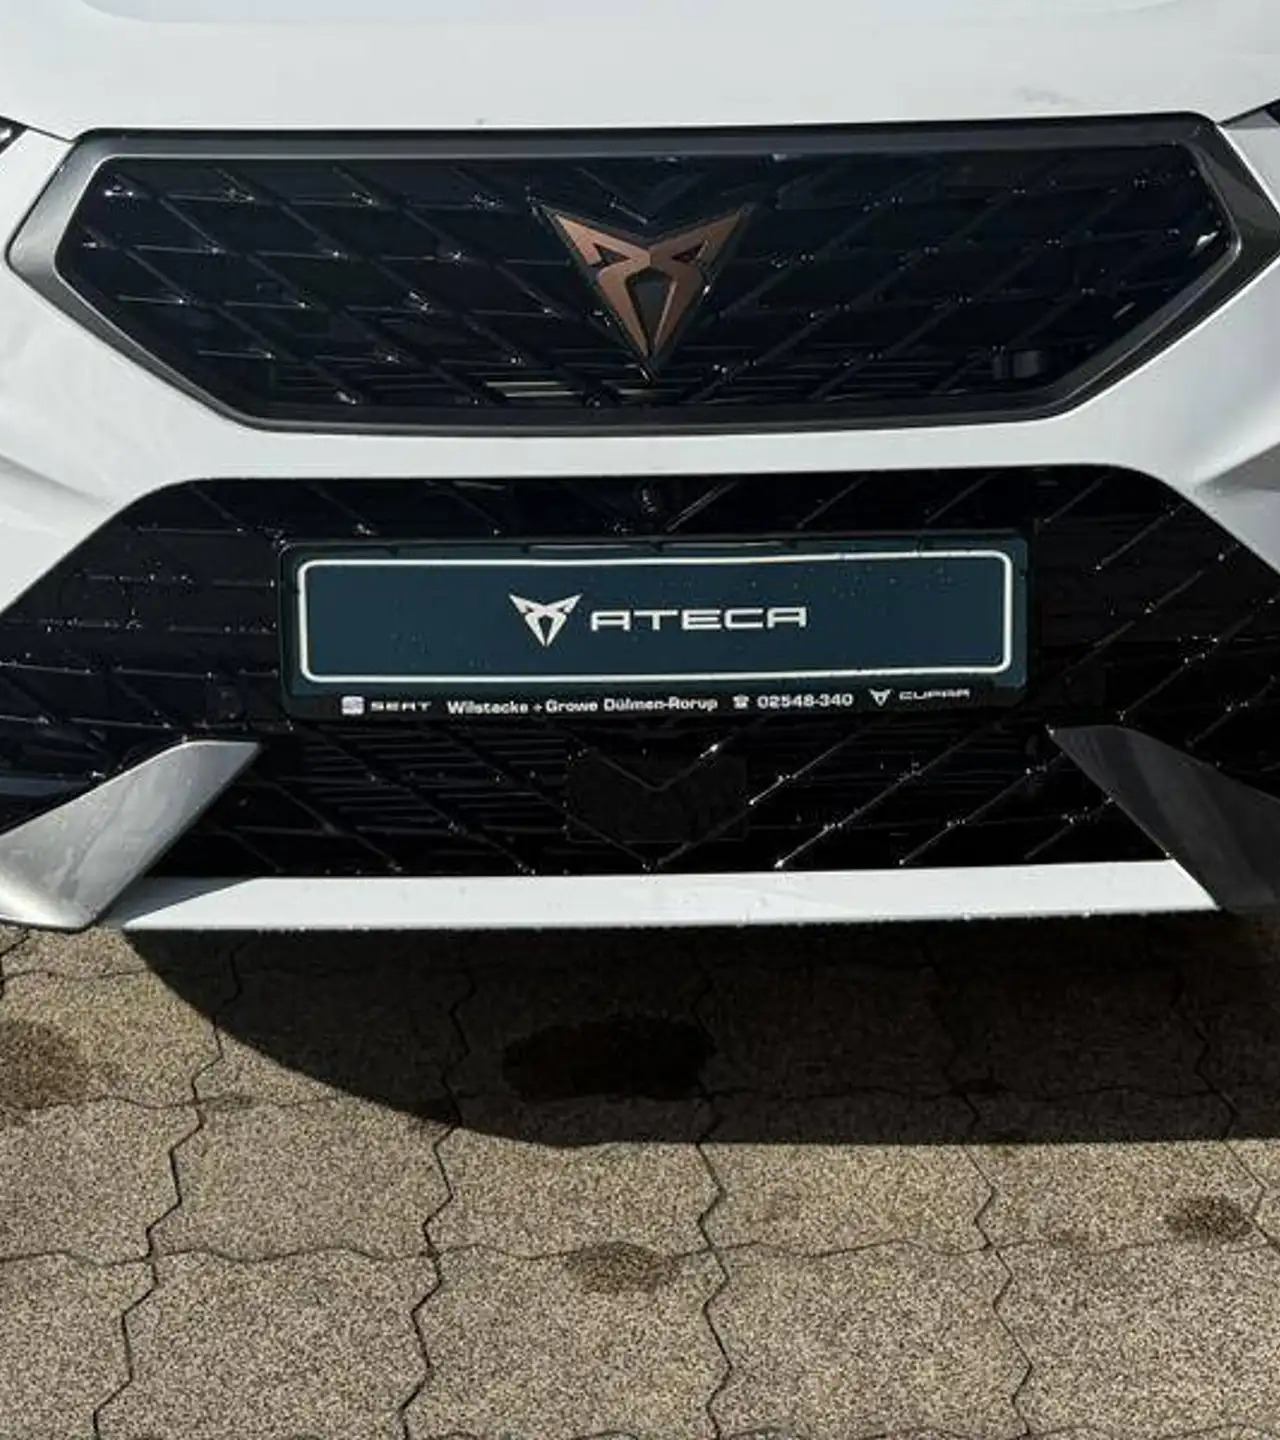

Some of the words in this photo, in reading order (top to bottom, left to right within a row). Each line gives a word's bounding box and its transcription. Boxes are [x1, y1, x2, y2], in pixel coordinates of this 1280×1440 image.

[590, 606, 807, 631] ATECA
[371, 701, 432, 712] SEAT
[603, 696, 718, 712] Dülmen-Rorup
[756, 693, 852, 710] 02548-340
[899, 688, 971, 701] CUPRA
